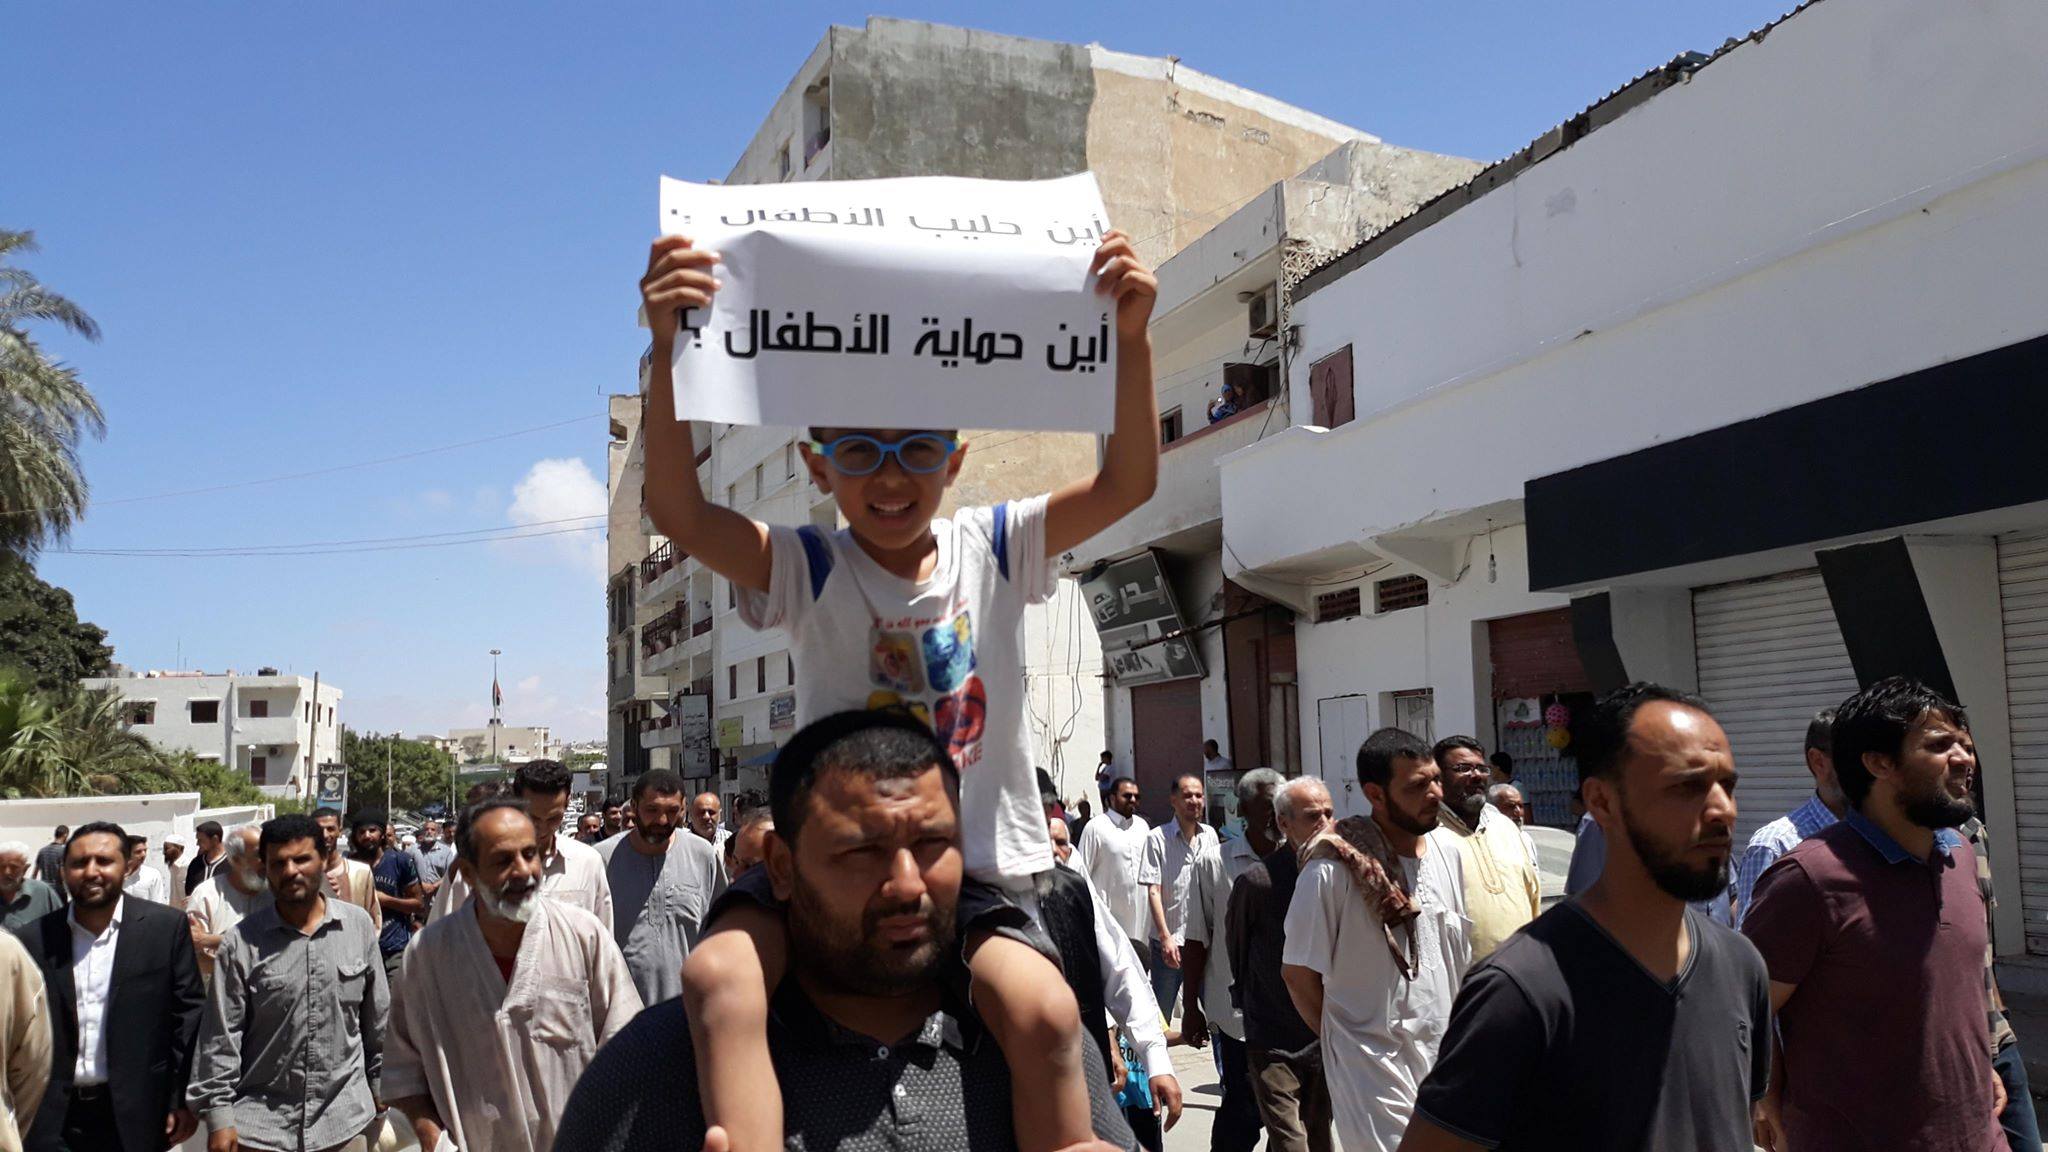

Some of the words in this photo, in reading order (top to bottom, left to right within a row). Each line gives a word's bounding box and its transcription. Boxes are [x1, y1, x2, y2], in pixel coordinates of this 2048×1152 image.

[909, 214, 1022, 241] حليب
[1047, 213, 1105, 246] أين
[724, 308, 890, 360] الأطفال
[913, 316, 1024, 369] حماية
[1046, 312, 1109, 374] أين
